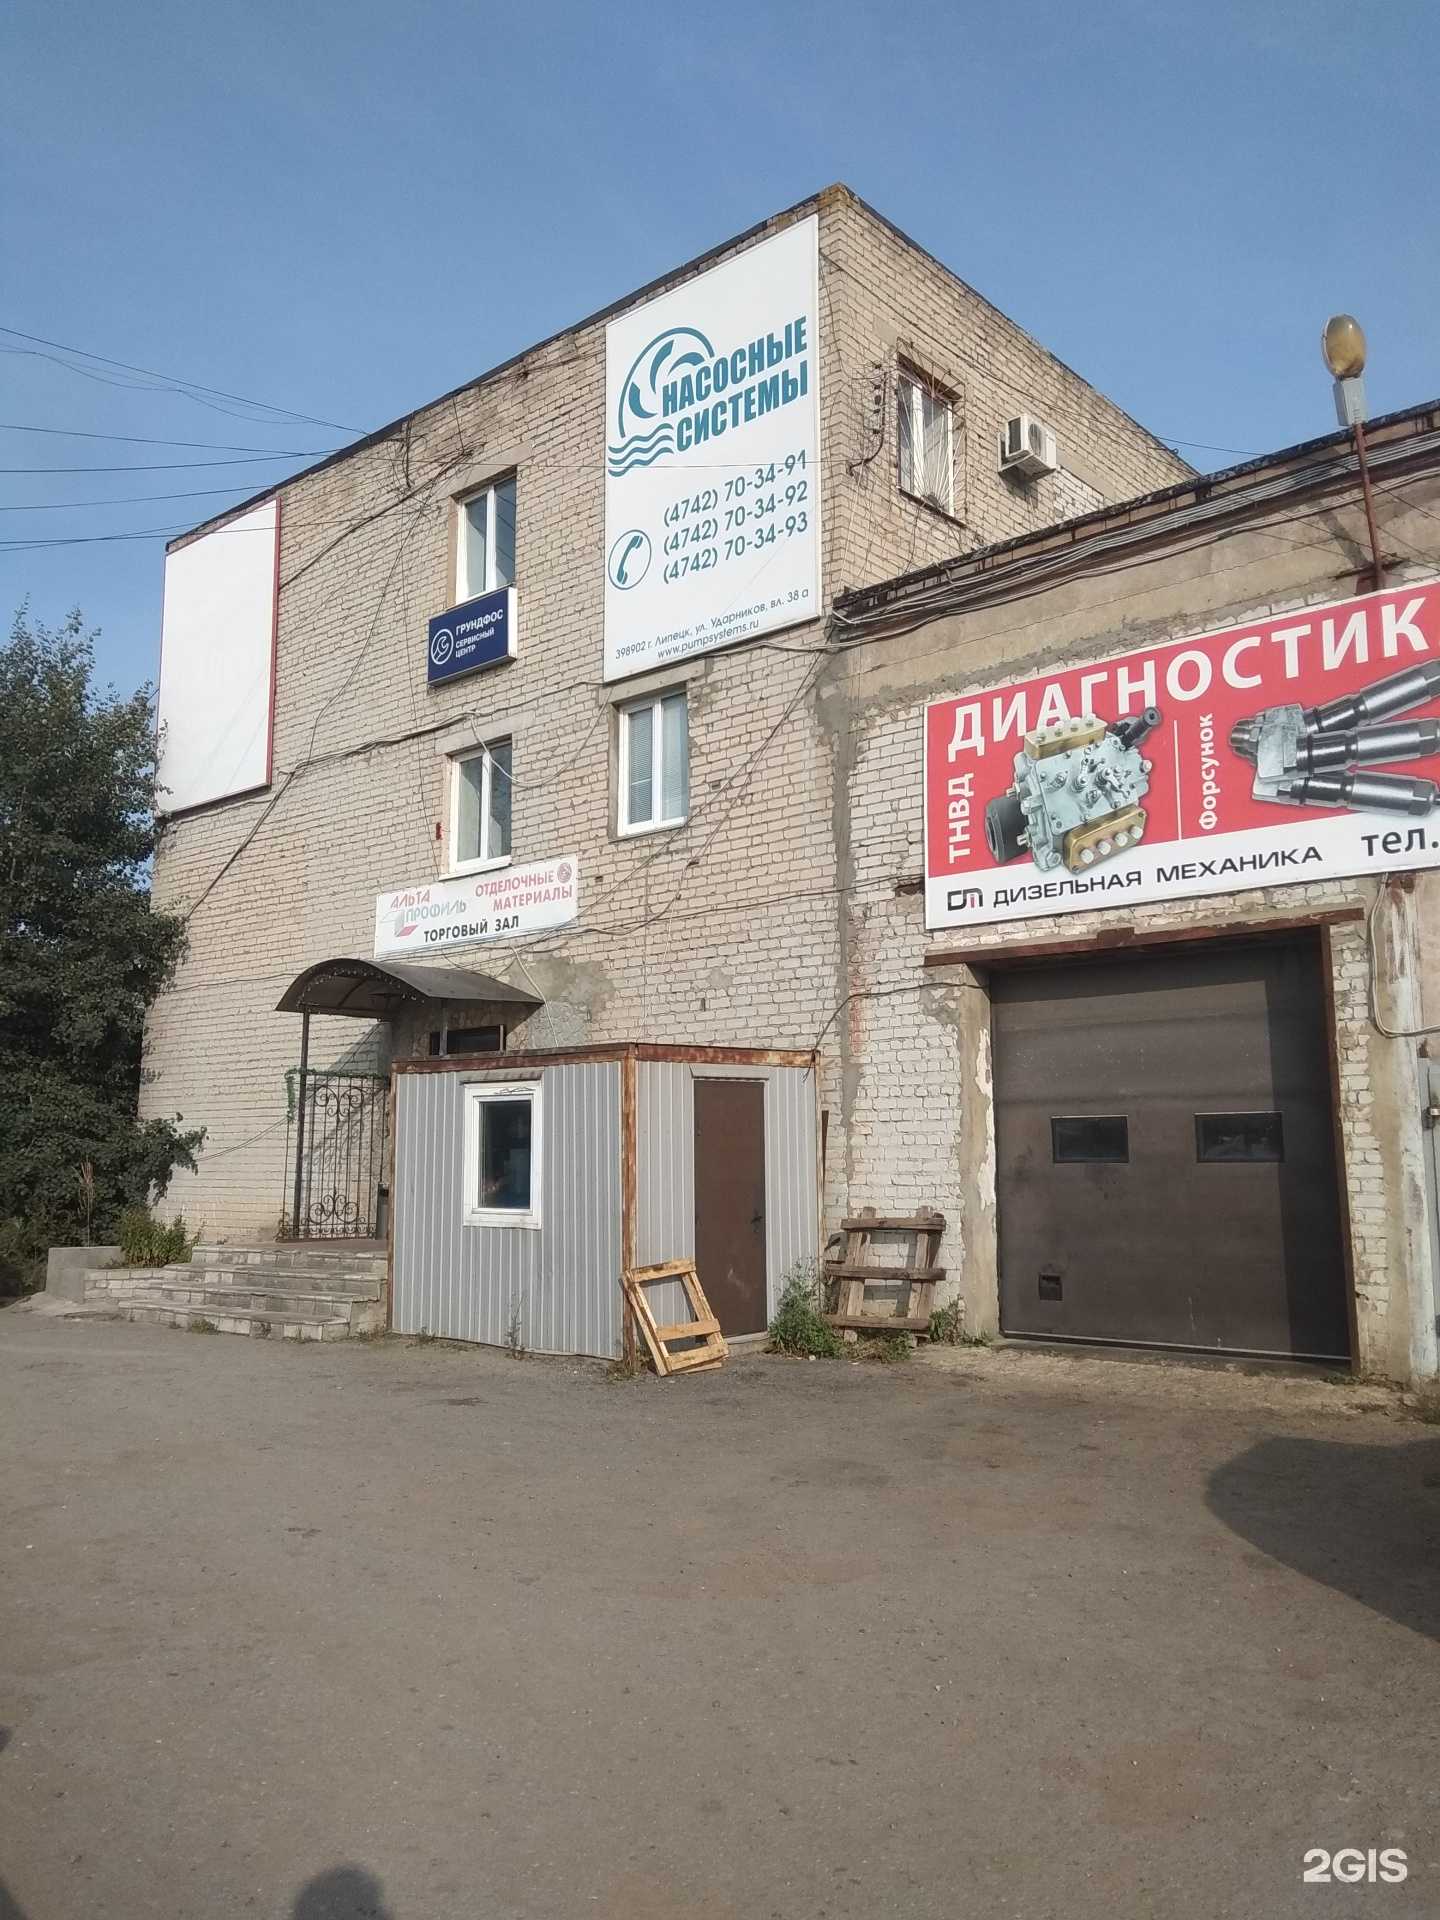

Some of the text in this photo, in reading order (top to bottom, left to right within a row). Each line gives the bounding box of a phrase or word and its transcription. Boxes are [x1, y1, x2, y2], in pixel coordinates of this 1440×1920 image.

[662, 316, 807, 418] НАСОСНЫЕ
[676, 360, 808, 451] СИСТЕМЫ
[664, 450, 807, 527] (4742) 70-34-91
[664, 480, 808, 556] (4742) 70-34-92
[663, 511, 808, 584] (4742) 70-34-93
[455, 609, 504, 636] ГРУНДФОС
[455, 627, 495, 649] СЕРВИСНЫЙ
[657, 619, 759, 659] www.pumpsystems.ru
[455, 644, 476, 658] ЦЕНТР
[615, 640, 646, 659] 398902
[948, 597, 1440, 763] ДИАГНОСТИК
[1199, 713, 1221, 830] Форсунок
[948, 772, 974, 864] ТНВД
[1361, 828, 1439, 857] тел.
[475, 869, 554, 897] ОТДЕЛОЧНЫЕ
[993, 846, 1323, 908] ДИЗЕЛЬНАЯ МЕХАНИКА
[390, 889, 430, 909] АЛЬТА
[406, 899, 466, 923] ПРОФИЛЬ
[493, 885, 573, 912] МАТЕРИАЛЫ
[424, 915, 519, 943] ТОРГОВЫЙ ЗАЛ
